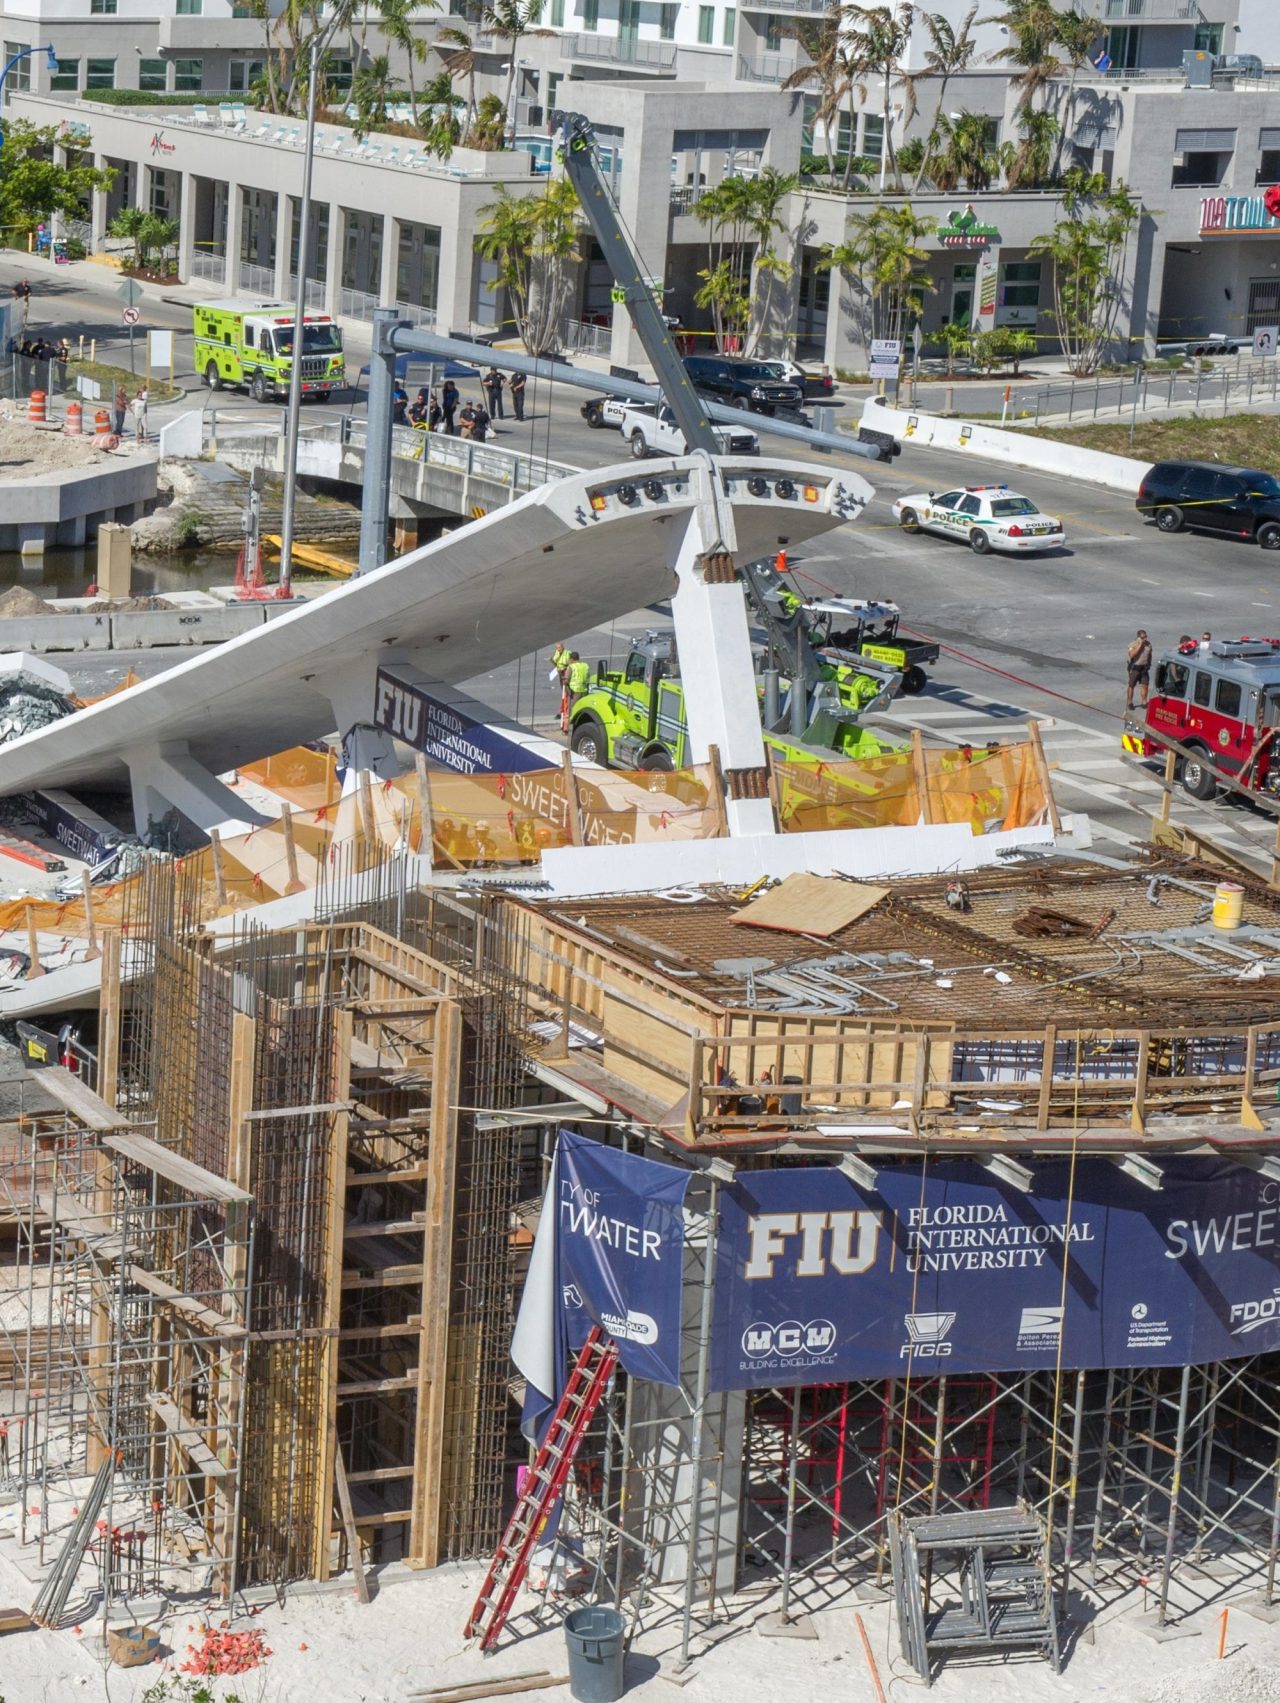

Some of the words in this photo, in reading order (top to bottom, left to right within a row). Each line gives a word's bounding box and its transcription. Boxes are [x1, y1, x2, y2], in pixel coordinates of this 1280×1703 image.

[933, 512, 969, 526] POLICE
[376, 677, 421, 742] FIU
[428, 704, 463, 735] FLORIDA
[426, 721, 492, 769] INTERNATIONAL
[426, 738, 476, 774] UNIVERSITY
[579, 788, 594, 808] OF
[56, 823, 100, 865] SWEETWAT
[584, 1188, 600, 1208] OF
[745, 1209, 884, 1280] FIU
[908, 1204, 1008, 1226] FLORIDA
[906, 1223, 1095, 1250] INTERNATIONAL
[1165, 1208, 1280, 1258] SWEE
[906, 1248, 1046, 1273] UNIVERSITY
[740, 1360, 778, 1370] BUILDING
[780, 1356, 834, 1368] EXCELLENCE
[900, 1342, 952, 1358] FIGG
